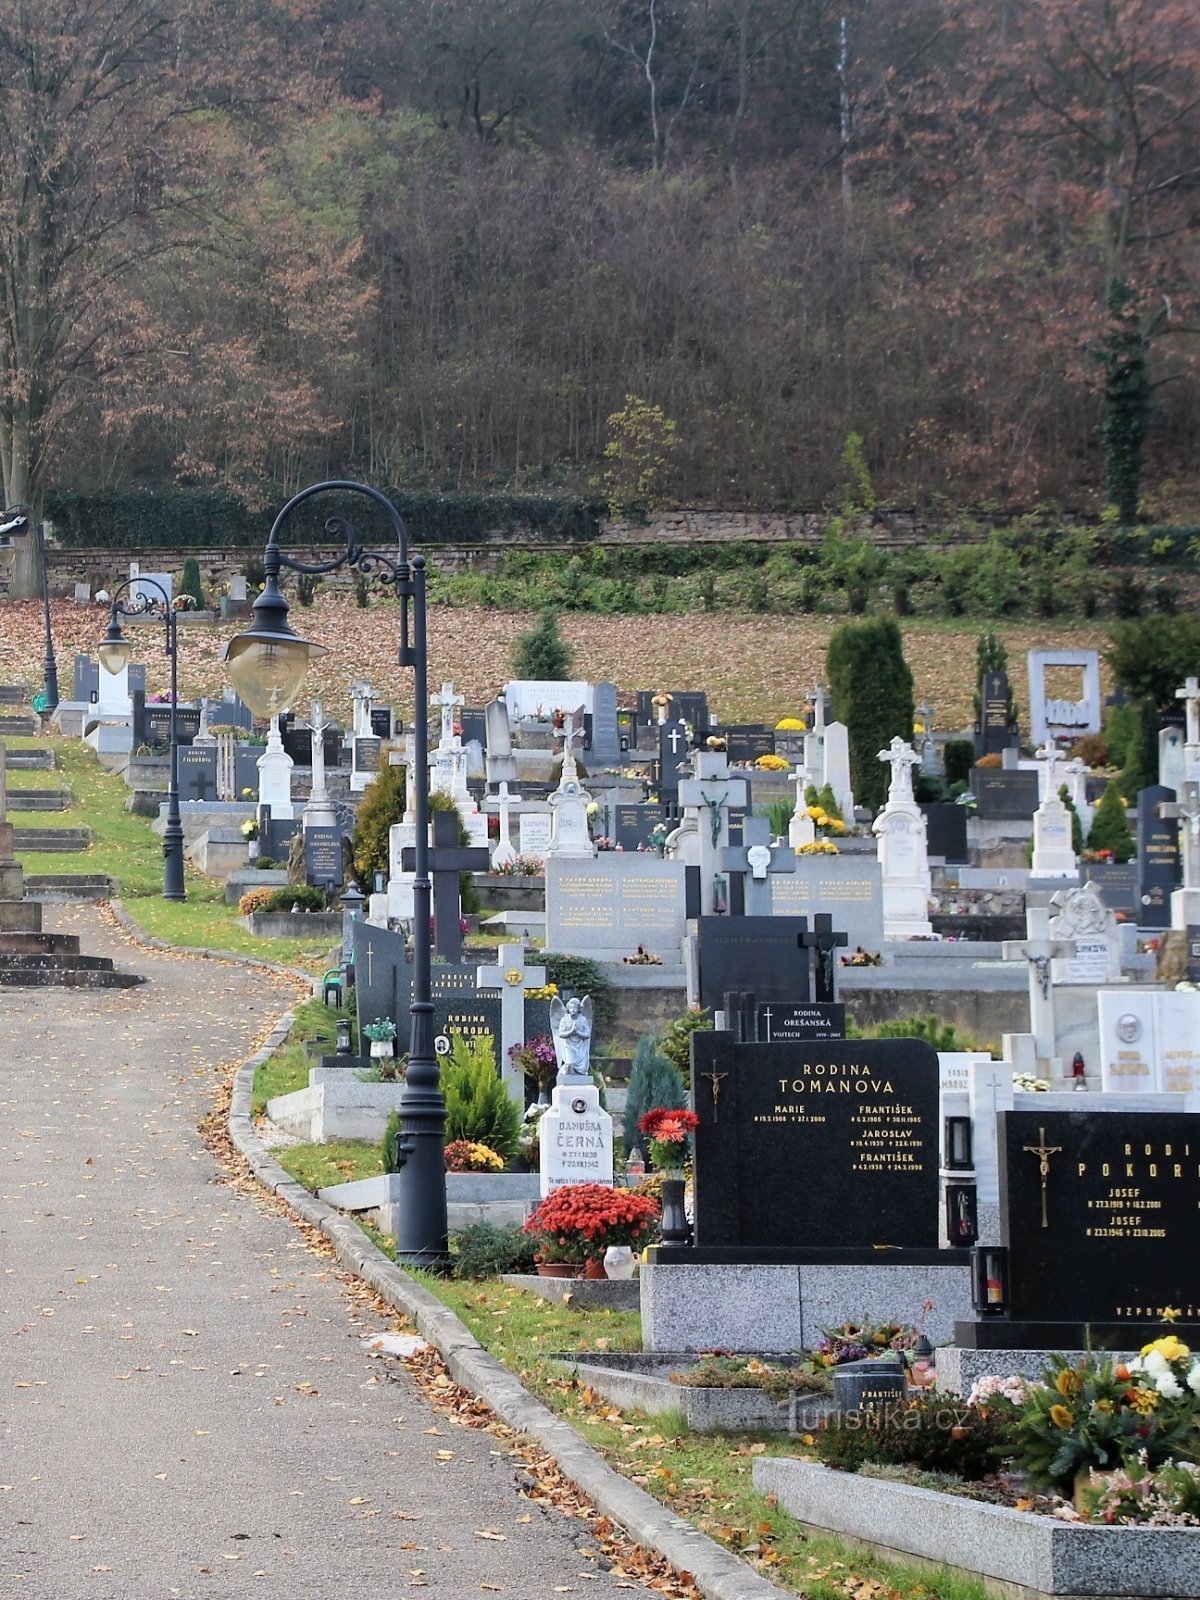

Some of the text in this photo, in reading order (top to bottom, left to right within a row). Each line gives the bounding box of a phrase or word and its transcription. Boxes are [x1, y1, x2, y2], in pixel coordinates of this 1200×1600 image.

[802, 1064, 871, 1076] RODINA
[778, 1079, 895, 1094] TOMANOVA
[774, 1103, 914, 1114] MARIE FRANTIŠEK
[559, 1119, 602, 1131] DANUŠKA
[861, 1129, 913, 1138] JAROSLAV
[556, 1132, 604, 1148] ČERNÁ
[1125, 1143, 1190, 1156] RODI
[860, 1151, 914, 1162] FRANTIŠEK
[1078, 1163, 1200, 1178] POKOR
[1108, 1188, 1141, 1198] JOSEF
[1109, 1216, 1142, 1226] JOSEF
